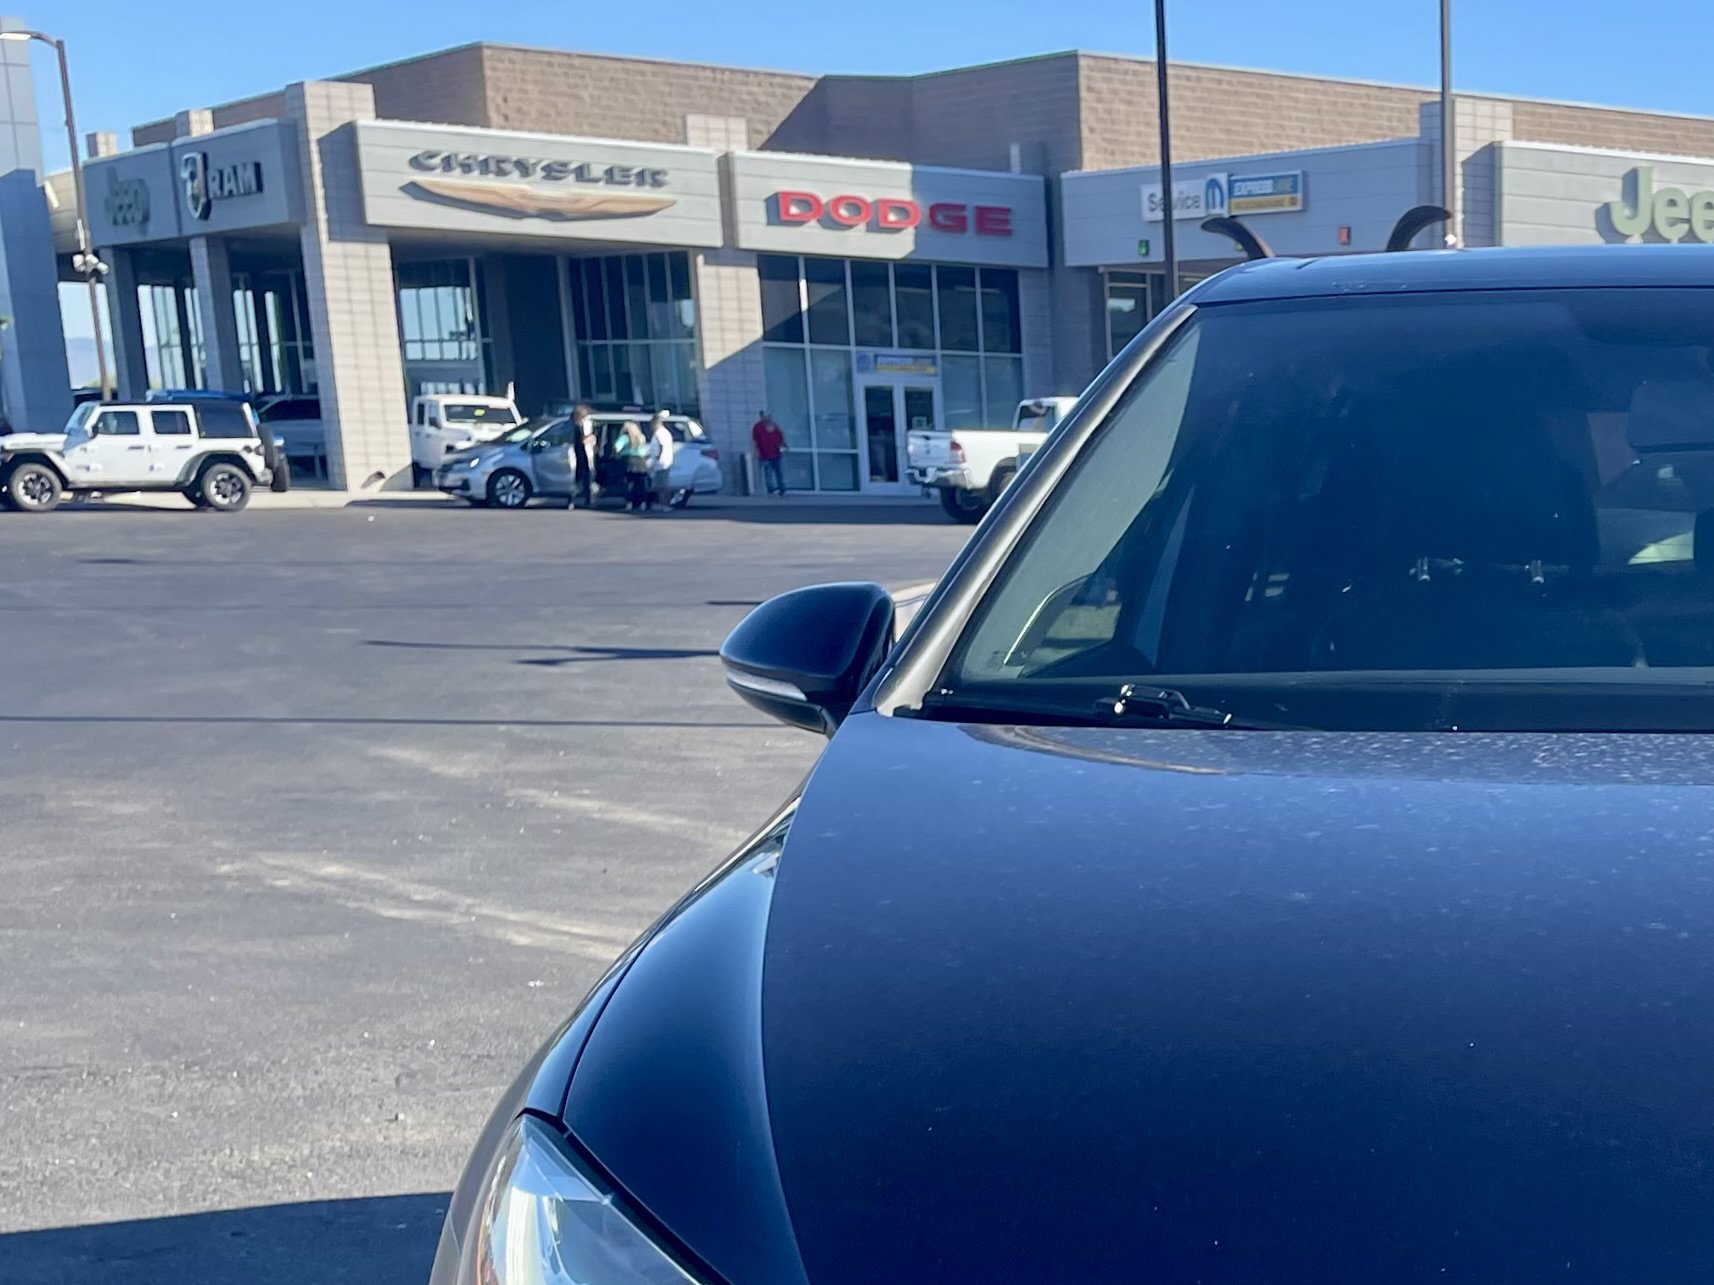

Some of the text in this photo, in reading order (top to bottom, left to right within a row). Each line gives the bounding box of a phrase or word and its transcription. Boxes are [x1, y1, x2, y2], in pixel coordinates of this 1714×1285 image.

[210, 163, 262, 201] RAM
[409, 150, 669, 187] CHRYSLER
[778, 191, 1013, 236] DODGE
[1148, 192, 1201, 212] Sevice
